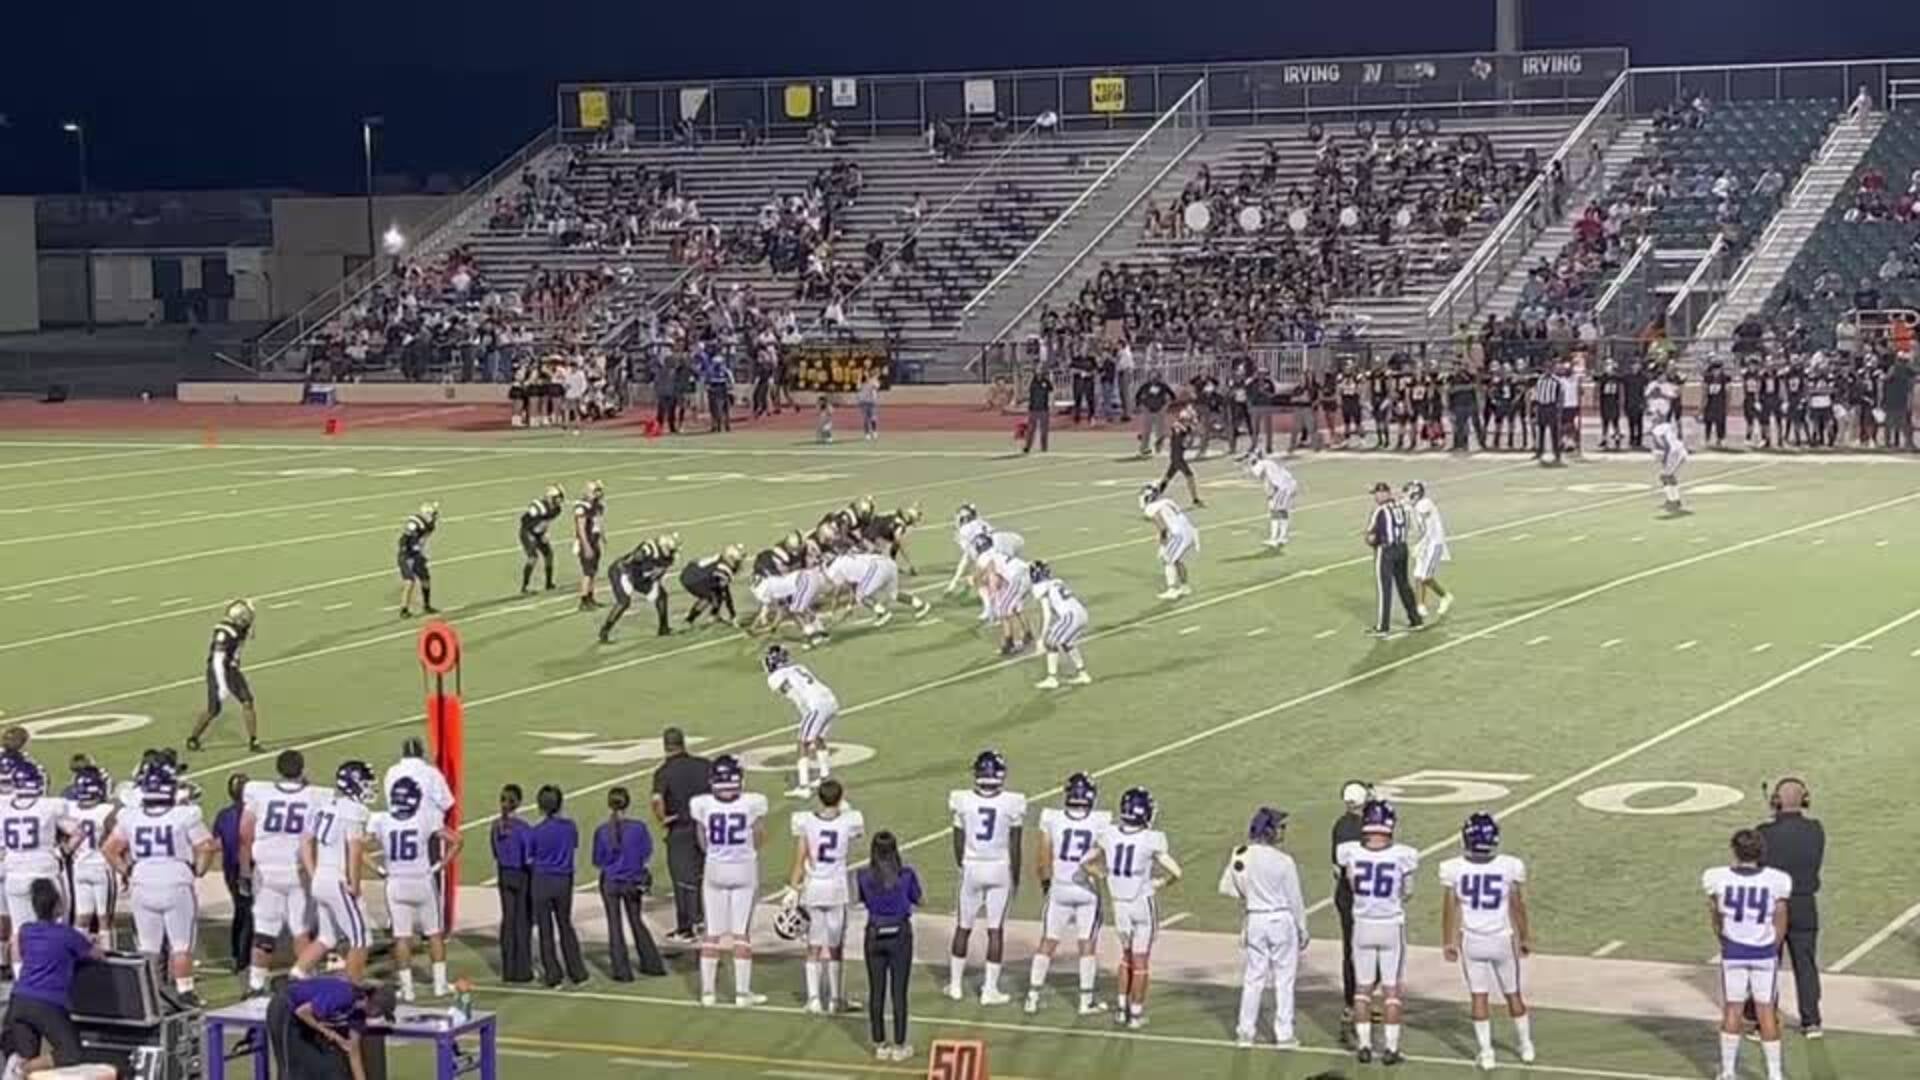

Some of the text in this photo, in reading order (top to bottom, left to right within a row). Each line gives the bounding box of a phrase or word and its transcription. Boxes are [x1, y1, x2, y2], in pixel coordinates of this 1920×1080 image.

[1283, 64, 1340, 84] IRVING
[1522, 55, 1581, 75] IRVING
[4, 816, 40, 849] 63
[264, 800, 308, 834] 66
[708, 813, 748, 846] 82
[975, 807, 996, 841] 3
[135, 825, 176, 858] 54
[389, 829, 419, 862] 16
[817, 831, 838, 863] 2
[1059, 828, 1093, 862] 13
[1113, 843, 1137, 878] 11
[1353, 861, 1397, 897] 26
[1460, 873, 1503, 910] 45
[1724, 885, 1770, 923] 44
[931, 1045, 977, 1080] 50
